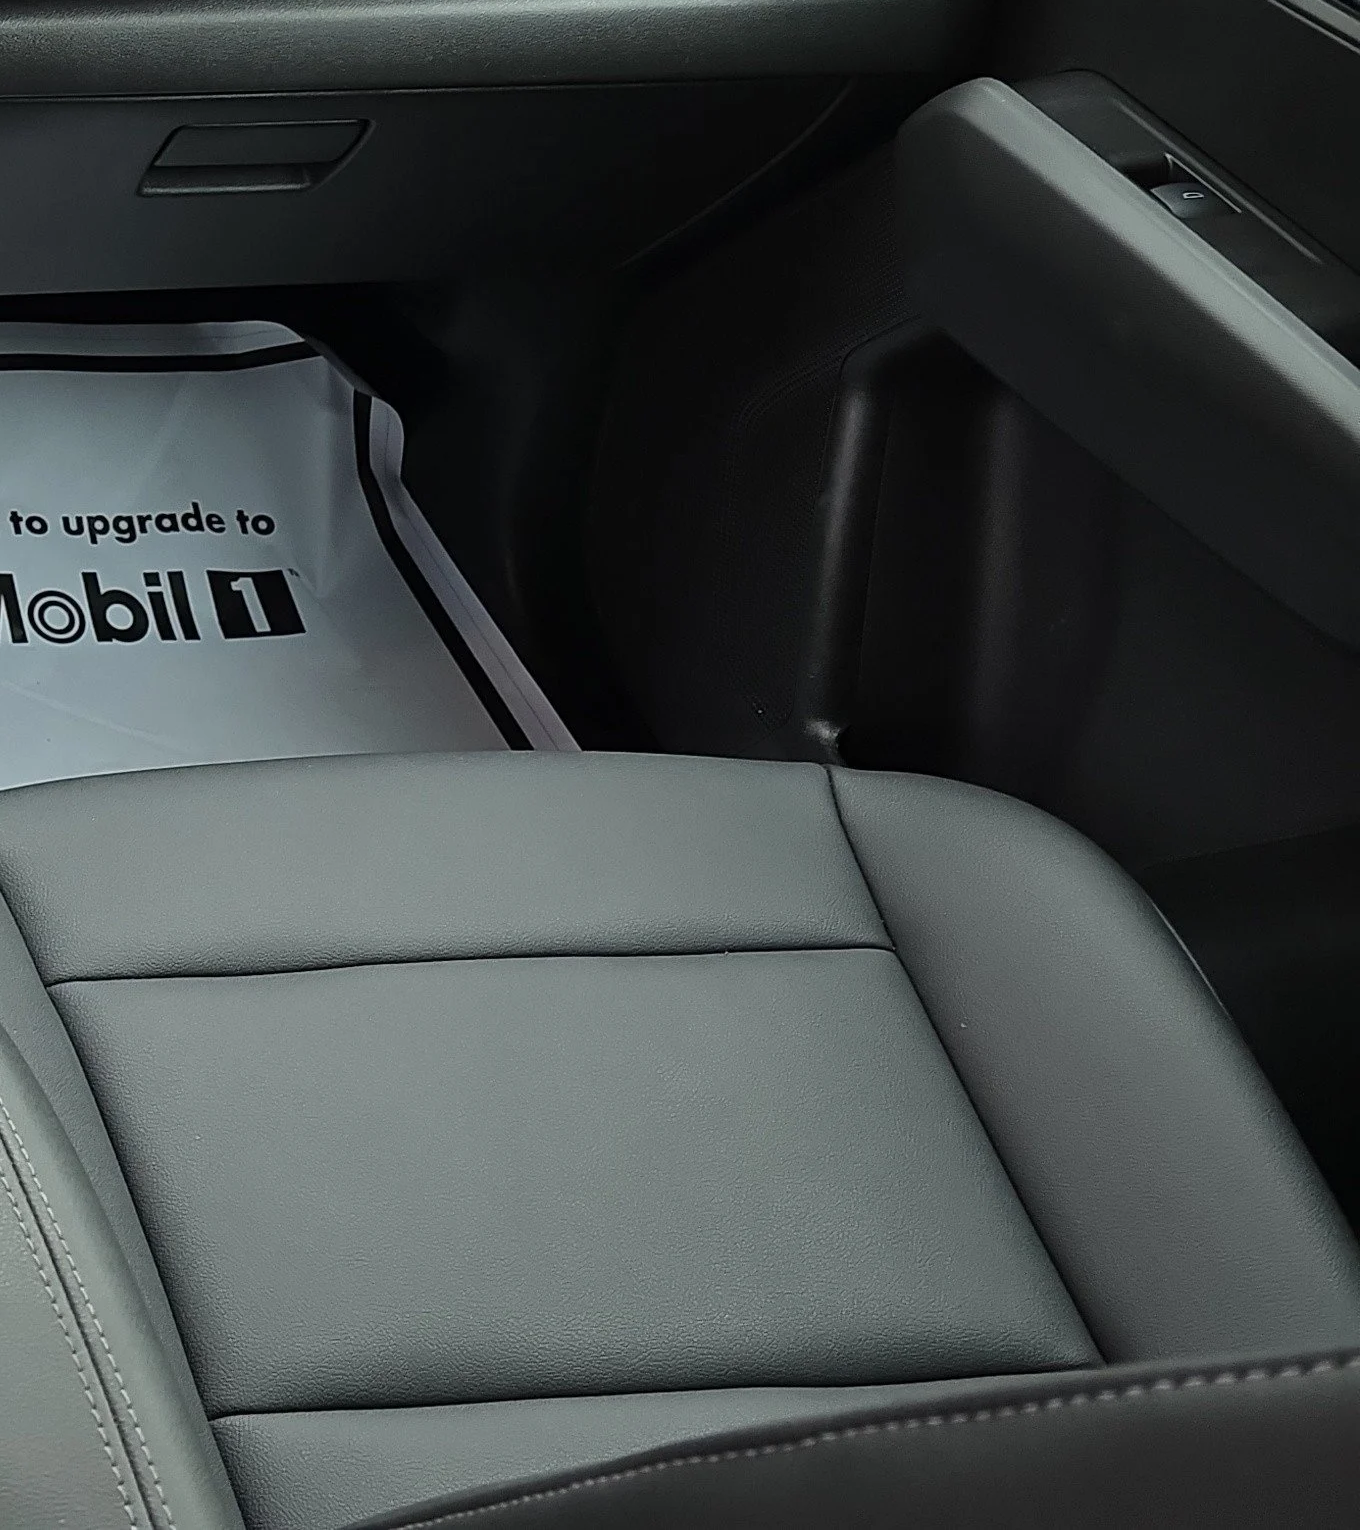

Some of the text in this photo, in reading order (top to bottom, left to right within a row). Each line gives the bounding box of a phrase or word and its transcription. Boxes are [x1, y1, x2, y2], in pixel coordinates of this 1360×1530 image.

[10, 510, 49, 537] to
[62, 501, 226, 544] upgrade
[236, 509, 276, 537] to
